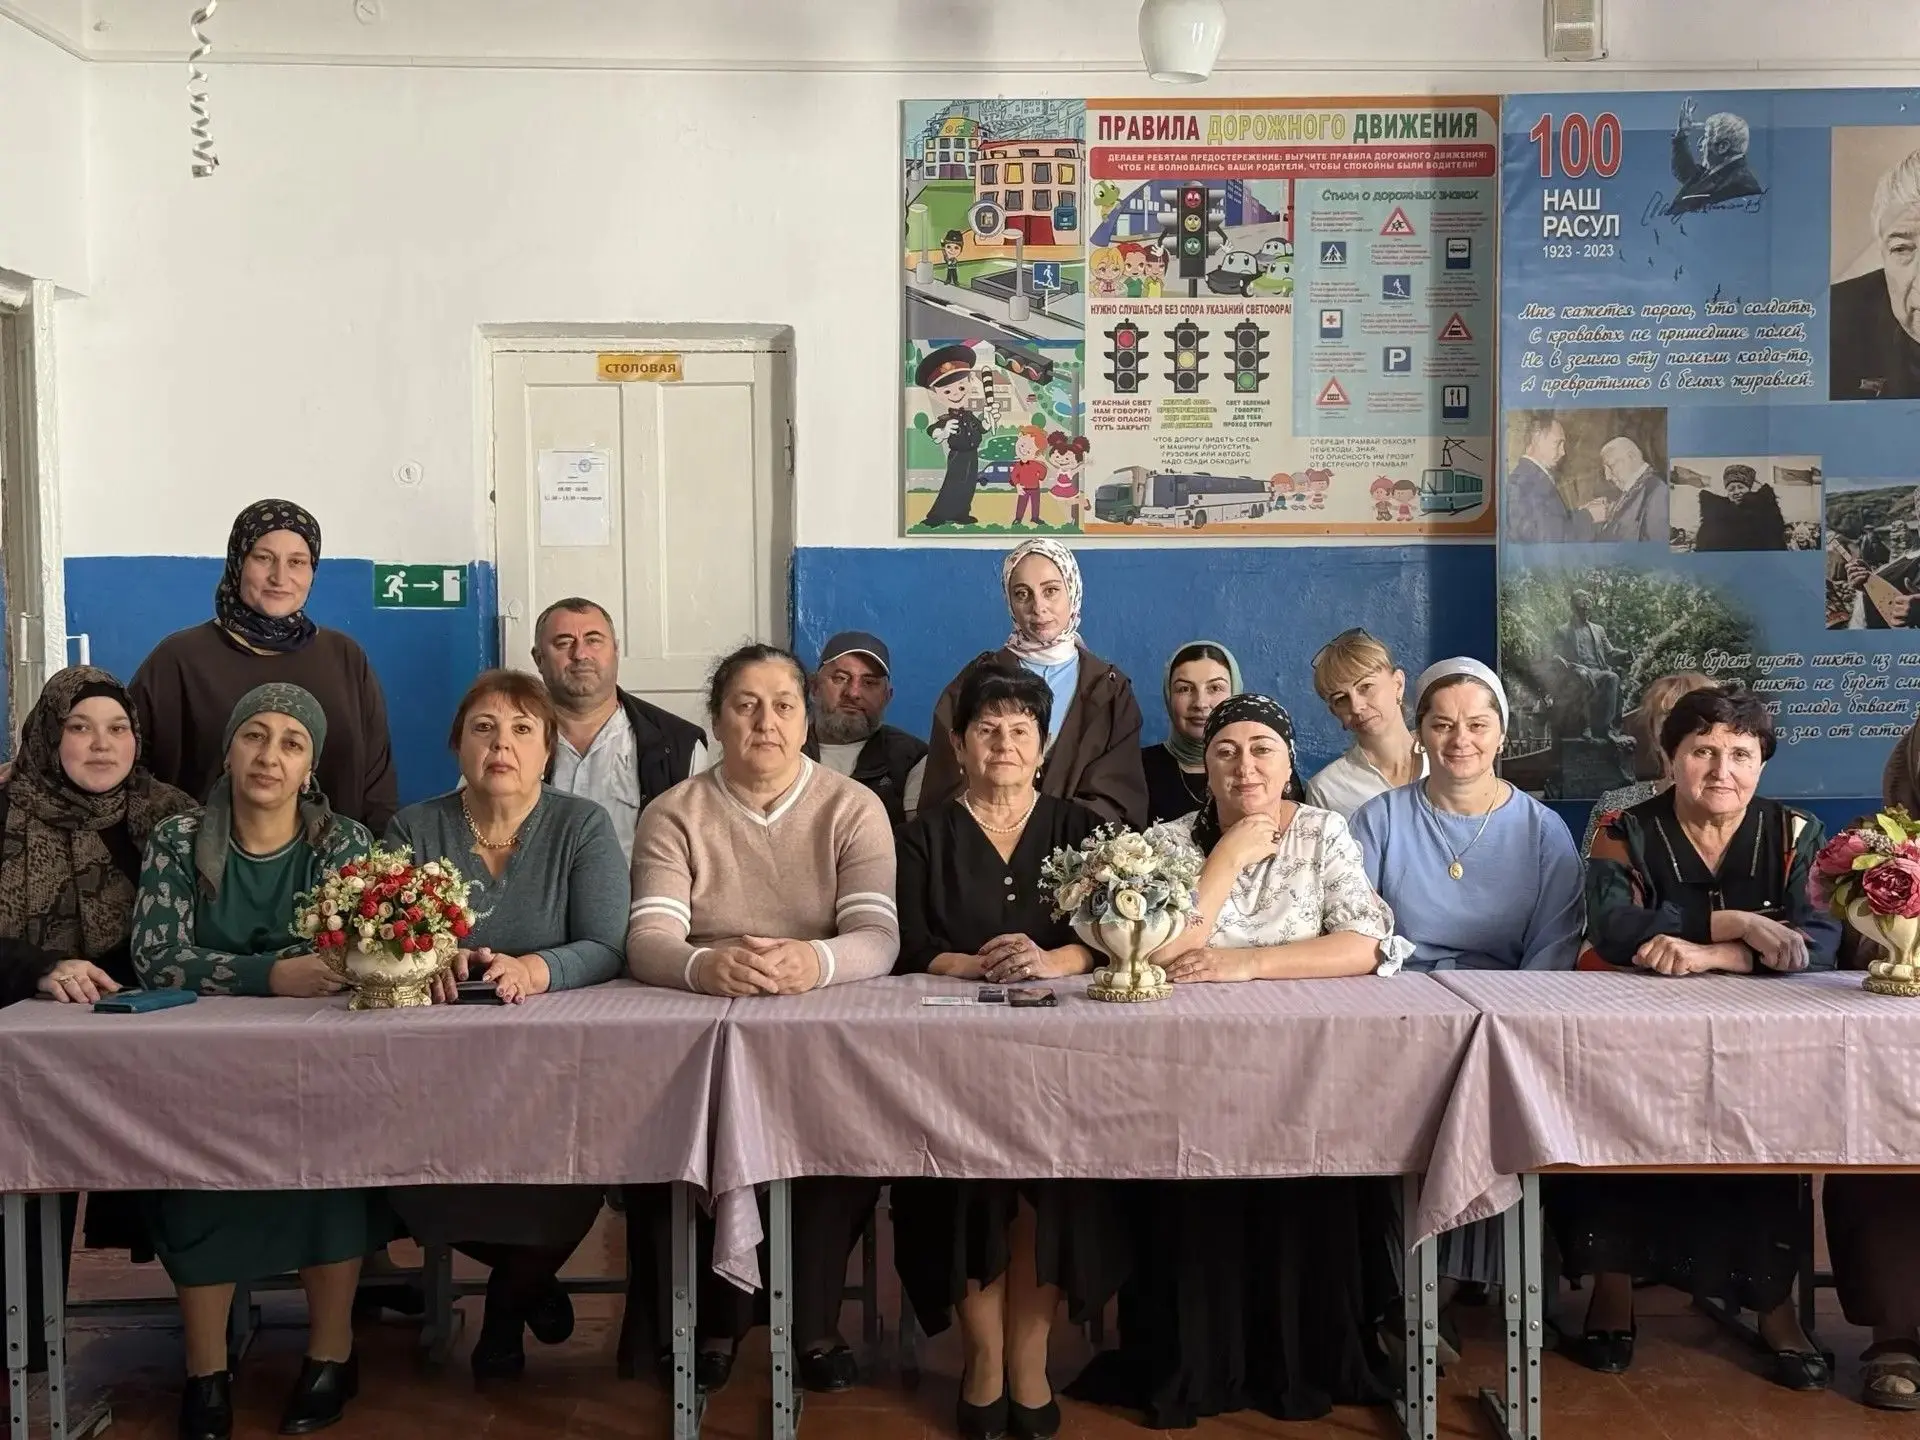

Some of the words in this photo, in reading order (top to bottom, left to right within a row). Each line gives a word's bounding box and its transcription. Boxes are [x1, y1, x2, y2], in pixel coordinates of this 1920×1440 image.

[1098, 114, 1200, 141] ПРАВИЛА
[1207, 114, 1346, 145] ДОРОЖНОГО
[1353, 112, 1478, 143] ДВИЖЕНИЯ
[1530, 112, 1622, 177] 100
[1108, 153, 1144, 162] ДЕЛАЕМ
[1147, 153, 1187, 161] РЕБЯТАМ
[1190, 153, 1282, 162] ПРЕДОСТЕРЕЖЕНИЕ:
[1285, 152, 1327, 161] ВЫУЧИТЕ
[1330, 152, 1372, 160] ПРАВИЛА
[1374, 152, 1431, 160] ДОРОЖНОГО
[1433, 151, 1487, 160] ДВИЖЕНИЯ!
[1117, 163, 1141, 171] ЧТОБ
[1143, 163, 1156, 171] НЕ
[1158, 163, 1225, 171] ВОЛНОВАЛИСЬ
[1227, 163, 1253, 171] ВАШИ
[1256, 163, 1307, 172] РОДИТЕЛИ,
[1309, 162, 1341, 170] ЧТОБЫ
[1344, 161, 1394, 170] СПОКОЙНЫ
[1397, 162, 1424, 170] БЫЛИ
[1426, 161, 1478, 170] ВОДИТЕЛИ!
[1321, 189, 1359, 201] Стихи
[1361, 191, 1370, 200] о
[1372, 189, 1436, 203] дорожных
[1438, 189, 1479, 200] знаках
[1543, 188, 1600, 211] НАШ
[1543, 215, 1620, 238] РАСУЛ
[1543, 246, 1572, 258] 1923
[1584, 244, 1614, 258] 2023
[1091, 305, 1116, 314] НУЖНО
[1118, 305, 1162, 314] СЛУШАТЬСЯ
[1164, 305, 1178, 314] БЕЗ
[1180, 305, 1204, 314] СПОРА
[1206, 303, 1244, 314] УКАЗАНИЙ
[1245, 304, 1291, 314] СВЕТОФОРА!
[1519, 303, 1555, 320] Мне
[1562, 303, 1634, 318] кажется
[1641, 305, 1697, 323] порою,
[1707, 301, 1738, 316] что
[1744, 299, 1816, 317] солдаты,
[1548, 328, 1624, 347] кровавых
[1630, 330, 1651, 341] не
[1657, 327, 1749, 347] пришедшие
[1756, 324, 1807, 340] полей,
[605, 363, 676, 374] СТОЛОВАЯ
[1522, 351, 1544, 368] Не
[1550, 349, 1560, 368] в
[1563, 354, 1621, 373] землю
[1626, 351, 1659, 373] эту
[1666, 353, 1731, 366] полегли
[1737, 348, 1814, 366] когда-то,
[1521, 376, 1535, 391] А
[1542, 371, 1652, 396] превратились
[1659, 371, 1670, 389] в
[1677, 369, 1724, 388] белых
[1732, 372, 1814, 394] журавлей.
[1092, 398, 1130, 406] КРАСНЫЙ
[1675, 653, 1697, 669] Не
[1703, 648, 1750, 674] будет
[1757, 653, 1803, 674] пусть
[1812, 653, 1864, 666] никто
[1872, 654, 1890, 671] из
[1753, 677, 1806, 691] никто
[1813, 679, 1833, 690] не
[1842, 671, 1889, 696] будет
[1788, 699, 1840, 715] голода
[1849, 694, 1908, 714] бывает
[1789, 727, 1821, 744] зло
[1829, 724, 1852, 737] от
